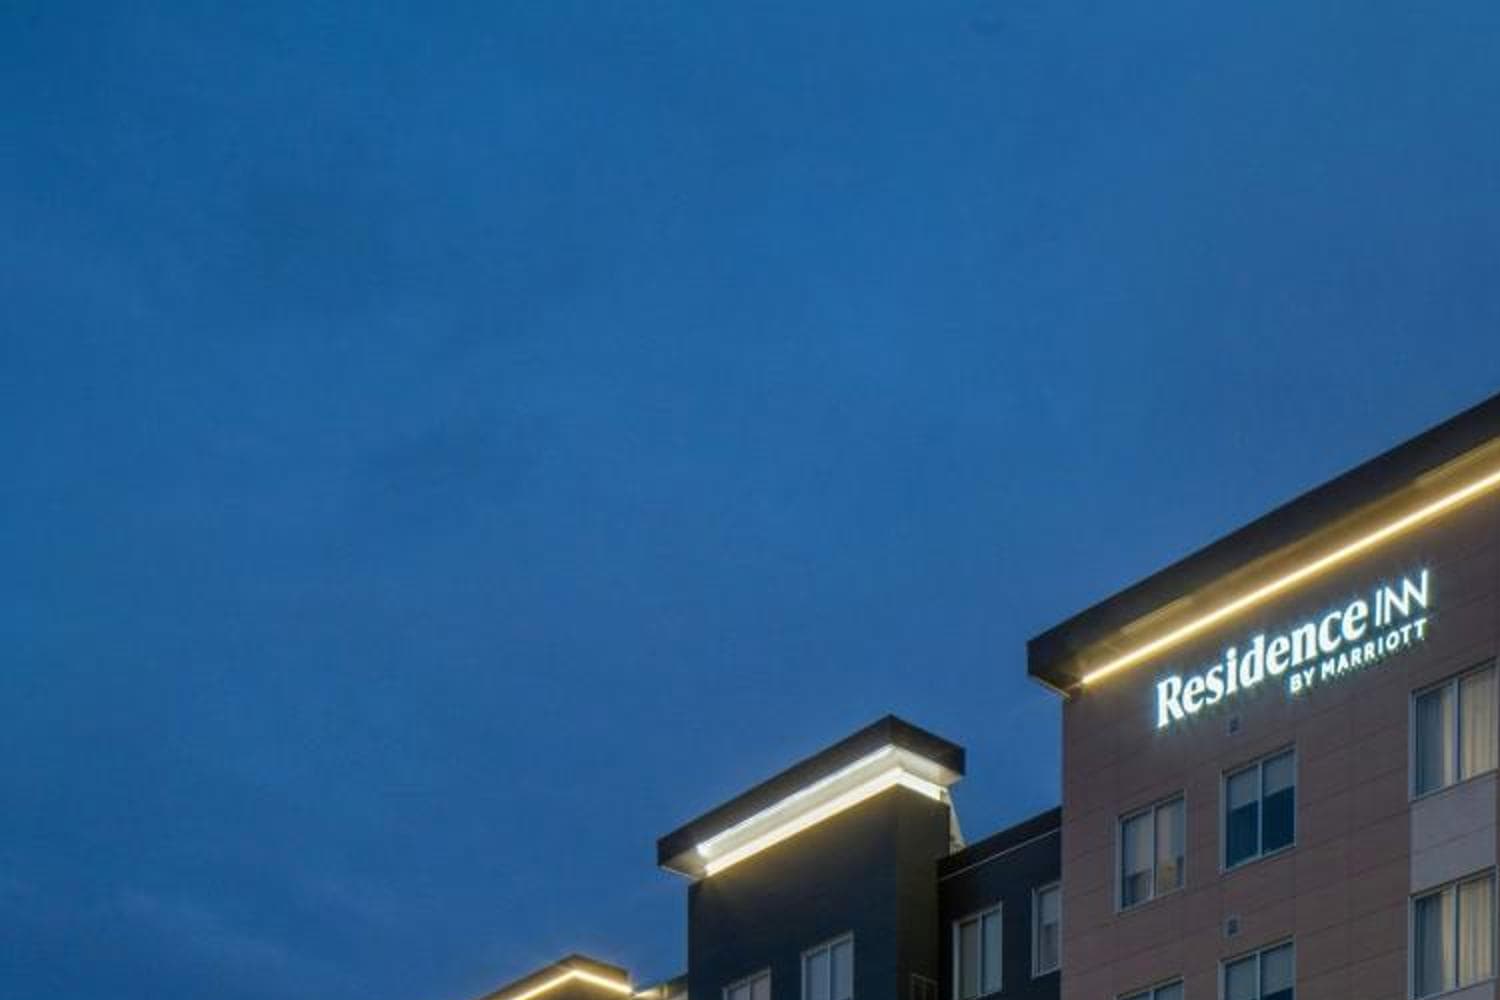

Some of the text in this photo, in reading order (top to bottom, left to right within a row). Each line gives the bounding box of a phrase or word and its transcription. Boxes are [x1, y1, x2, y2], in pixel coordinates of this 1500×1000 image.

[1156, 568, 1429, 729] Residence INN
[1289, 618, 1427, 694] BY MARRIOTT
